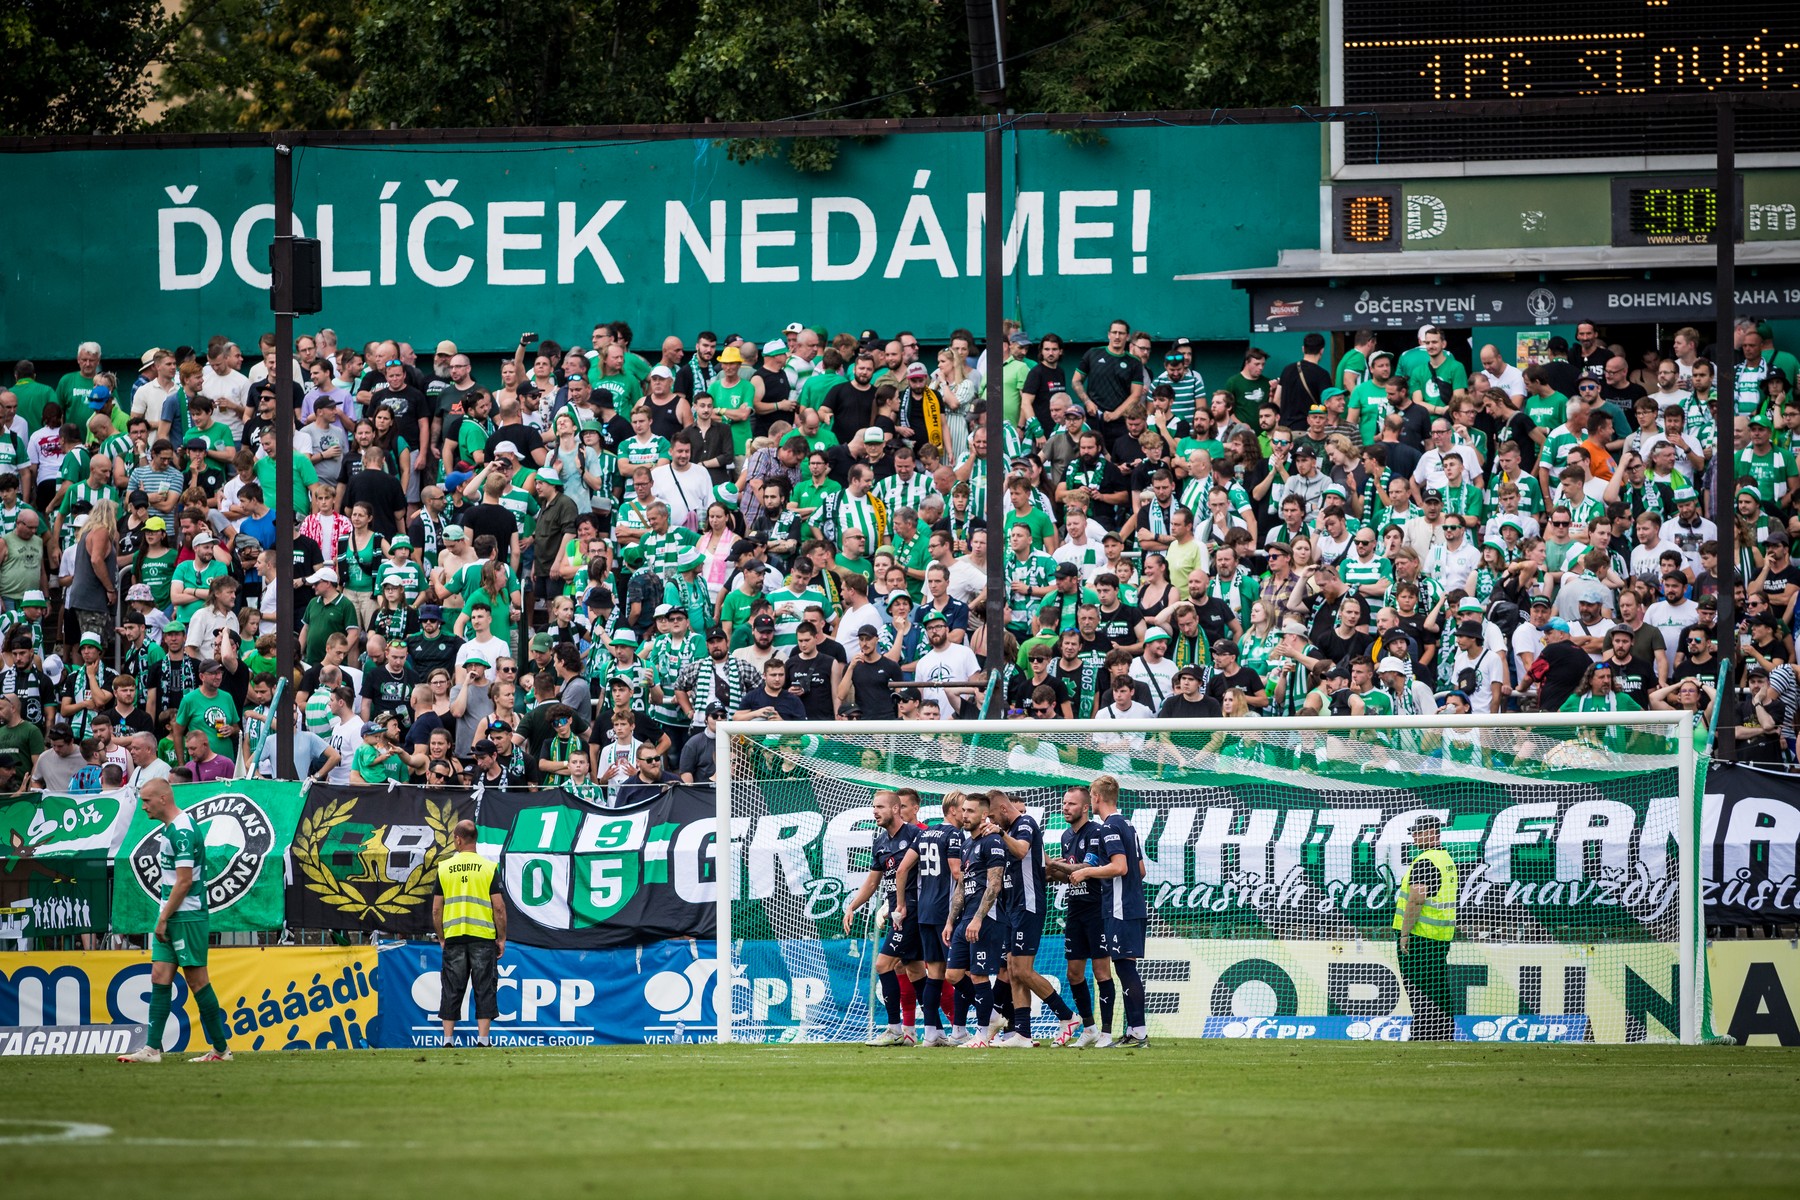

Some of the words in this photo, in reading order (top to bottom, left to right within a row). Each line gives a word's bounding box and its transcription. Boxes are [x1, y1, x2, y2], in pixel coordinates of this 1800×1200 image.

[1407, 195, 1447, 240] D
[1644, 188, 1717, 233] 90
[1350, 196, 1389, 242] 0
[157, 178, 627, 290] ĎOLÍČEK
[664, 169, 1151, 284] NEDÁME!
[1354, 295, 1476, 315] OBČERSTVENÍ
[1607, 291, 1713, 308] BOHEMIANS
[1734, 289, 1779, 305] RAHA
[448, 862, 482, 874] SECURITY
[892, 932, 903, 942] 28
[1016, 931, 1024, 941] 19
[1101, 934, 1107, 943] 3
[1112, 934, 1118, 943] 4
[976, 951, 987, 961] 20
[1257, 1019, 1316, 1040] ČPP
[1508, 1017, 1569, 1042] ČPP
[412, 1035, 463, 1047] VIENA
[467, 1035, 545, 1047] INURANCE
[549, 1035, 595, 1047] GROUP
[644, 1035, 694, 1045] VIENA
